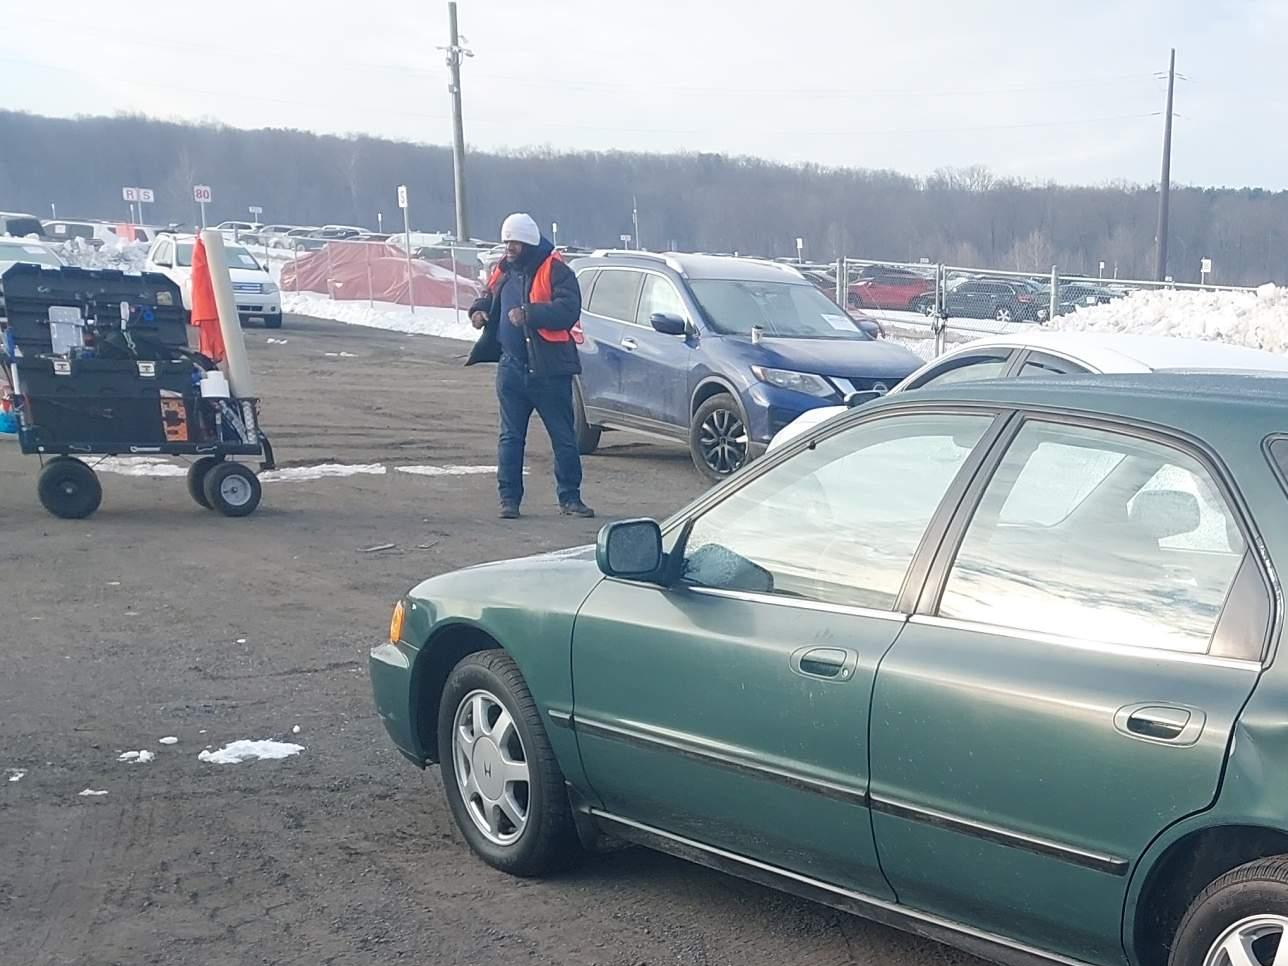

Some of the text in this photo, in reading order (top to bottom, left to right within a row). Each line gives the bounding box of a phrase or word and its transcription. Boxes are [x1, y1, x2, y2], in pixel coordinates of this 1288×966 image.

[126, 189, 152, 201] R S
[195, 188, 210, 200] 80
